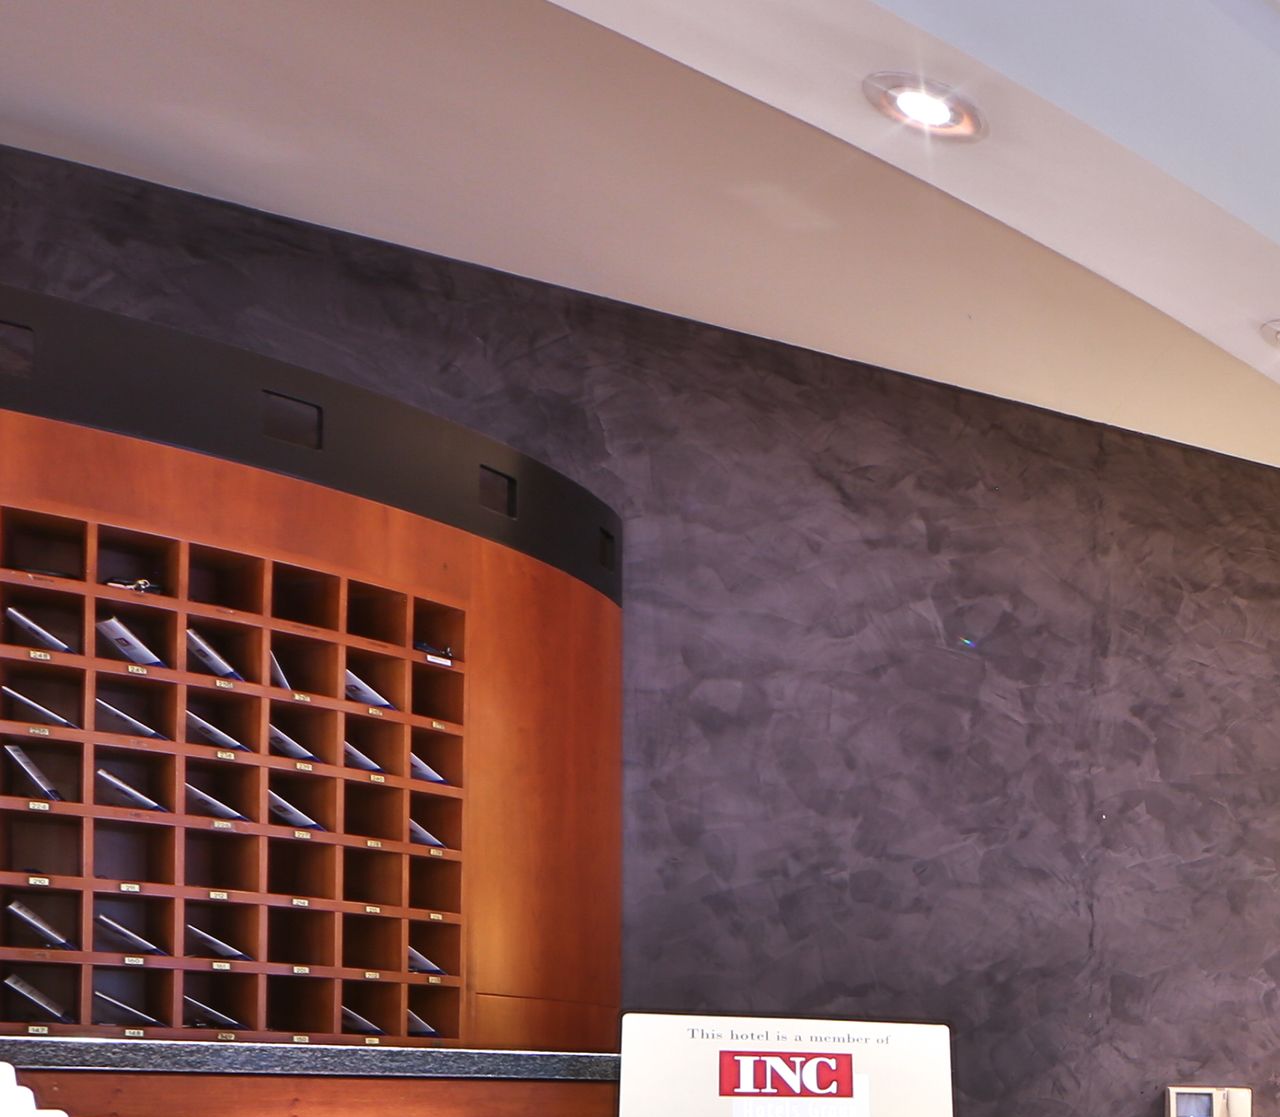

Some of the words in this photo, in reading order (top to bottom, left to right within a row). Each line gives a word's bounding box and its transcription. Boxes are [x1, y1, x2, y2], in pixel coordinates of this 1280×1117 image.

[687, 1028, 722, 1039] This
[731, 1030, 769, 1041] hotel
[777, 1031, 787, 1041] is
[810, 1033, 871, 1043] member
[876, 1035, 891, 1044] of
[734, 1055, 838, 1095] INC
